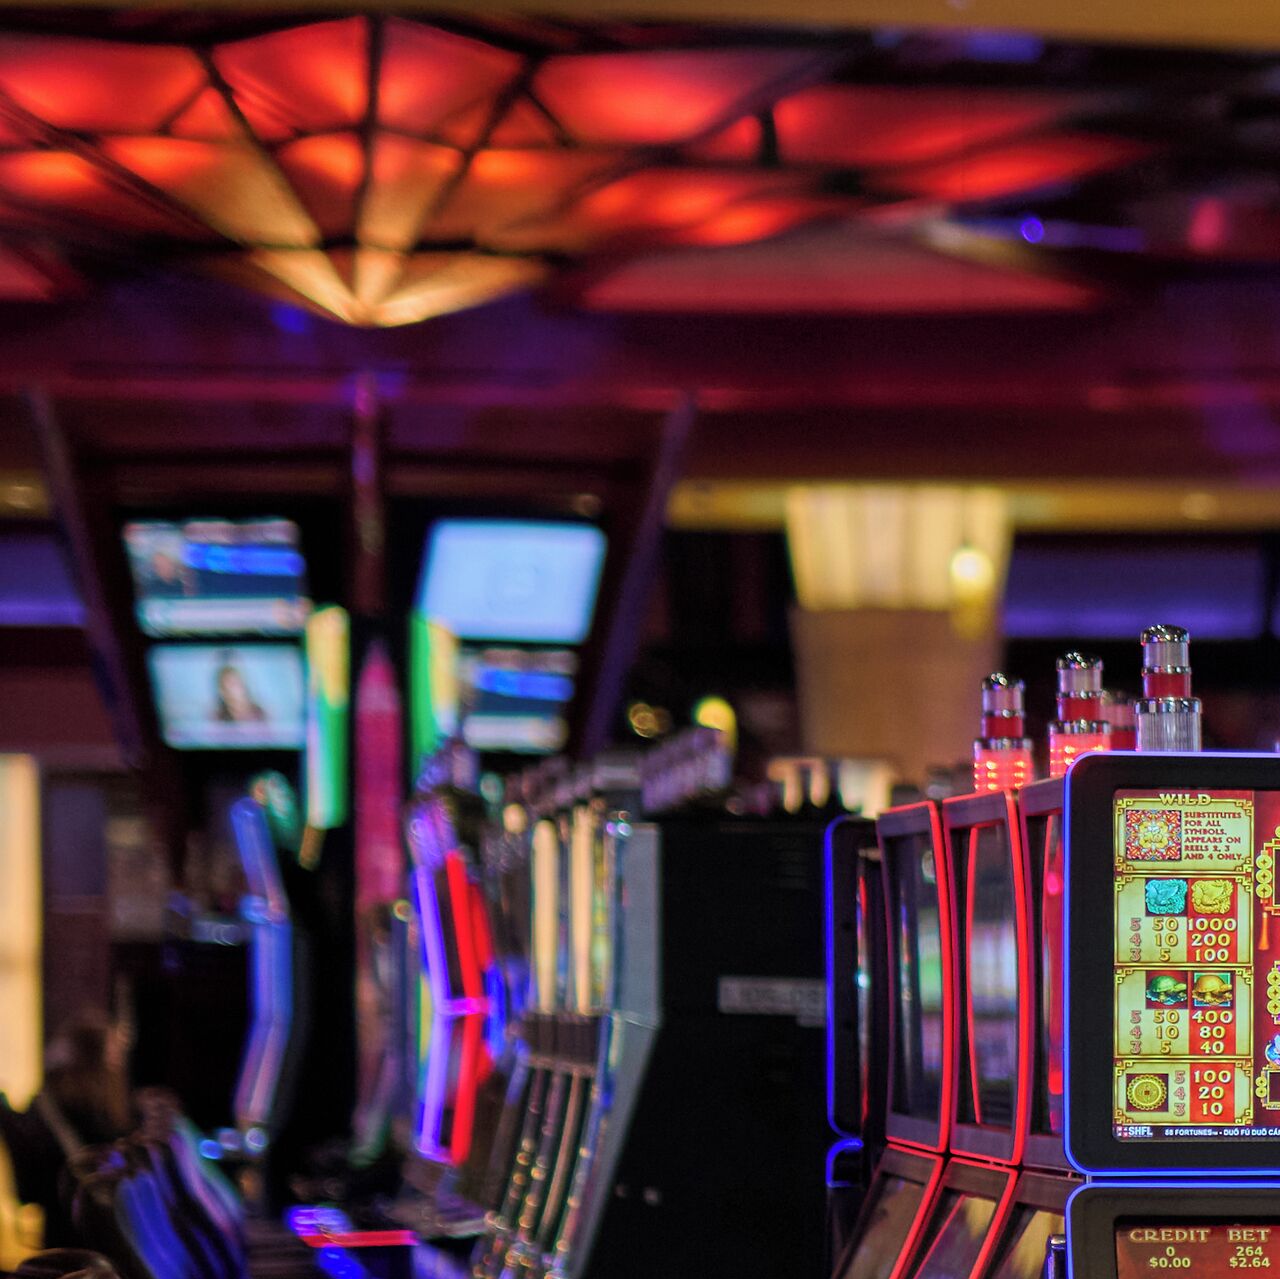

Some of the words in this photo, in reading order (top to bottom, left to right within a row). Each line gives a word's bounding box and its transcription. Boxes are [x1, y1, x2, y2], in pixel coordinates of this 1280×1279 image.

[1159, 793, 1212, 806] WILD
[1184, 811, 1242, 819] SUBSTITUTES
[1184, 836, 1223, 844] APPEARS
[1226, 836, 1241, 844] ON
[1184, 845, 1209, 853] REELS
[1184, 853, 1205, 861] AND
[1208, 853, 1214, 861] 4
[1130, 917, 1142, 932] 5
[1152, 917, 1180, 932] 50
[1188, 918, 1237, 932] 1000
[1130, 932, 1142, 947] 4
[1155, 932, 1179, 947] 10
[1191, 933, 1231, 947] 200
[1130, 948, 1142, 962] 3
[1159, 948, 1171, 962] 5
[1195, 949, 1230, 962] 100
[1130, 1009, 1142, 1024] 5
[1153, 1009, 1180, 1024] 50
[1192, 1010, 1233, 1024] 400
[1130, 1025, 1142, 1039] 4
[1155, 1025, 1179, 1039] 10
[1199, 1025, 1226, 1039] 80
[1130, 1040, 1142, 1055] 3
[1160, 1040, 1172, 1055] 5
[1200, 1041, 1225, 1055] 40
[1173, 1070, 1186, 1084] 5
[1194, 1070, 1232, 1084] 100
[1173, 1086, 1186, 1100] 4
[1199, 1086, 1226, 1100] 20
[1173, 1102, 1186, 1116] 3
[1202, 1102, 1224, 1116] 10
[1128, 1126, 1153, 1136] SHFL
[1129, 1228, 1211, 1243] CREDIT
[1227, 1228, 1271, 1243] BET
[1165, 1246, 1176, 1257] 0
[1235, 1245, 1264, 1257] 264
[1149, 1256, 1191, 1269] $0.00
[1229, 1256, 1271, 1268] $2.64
